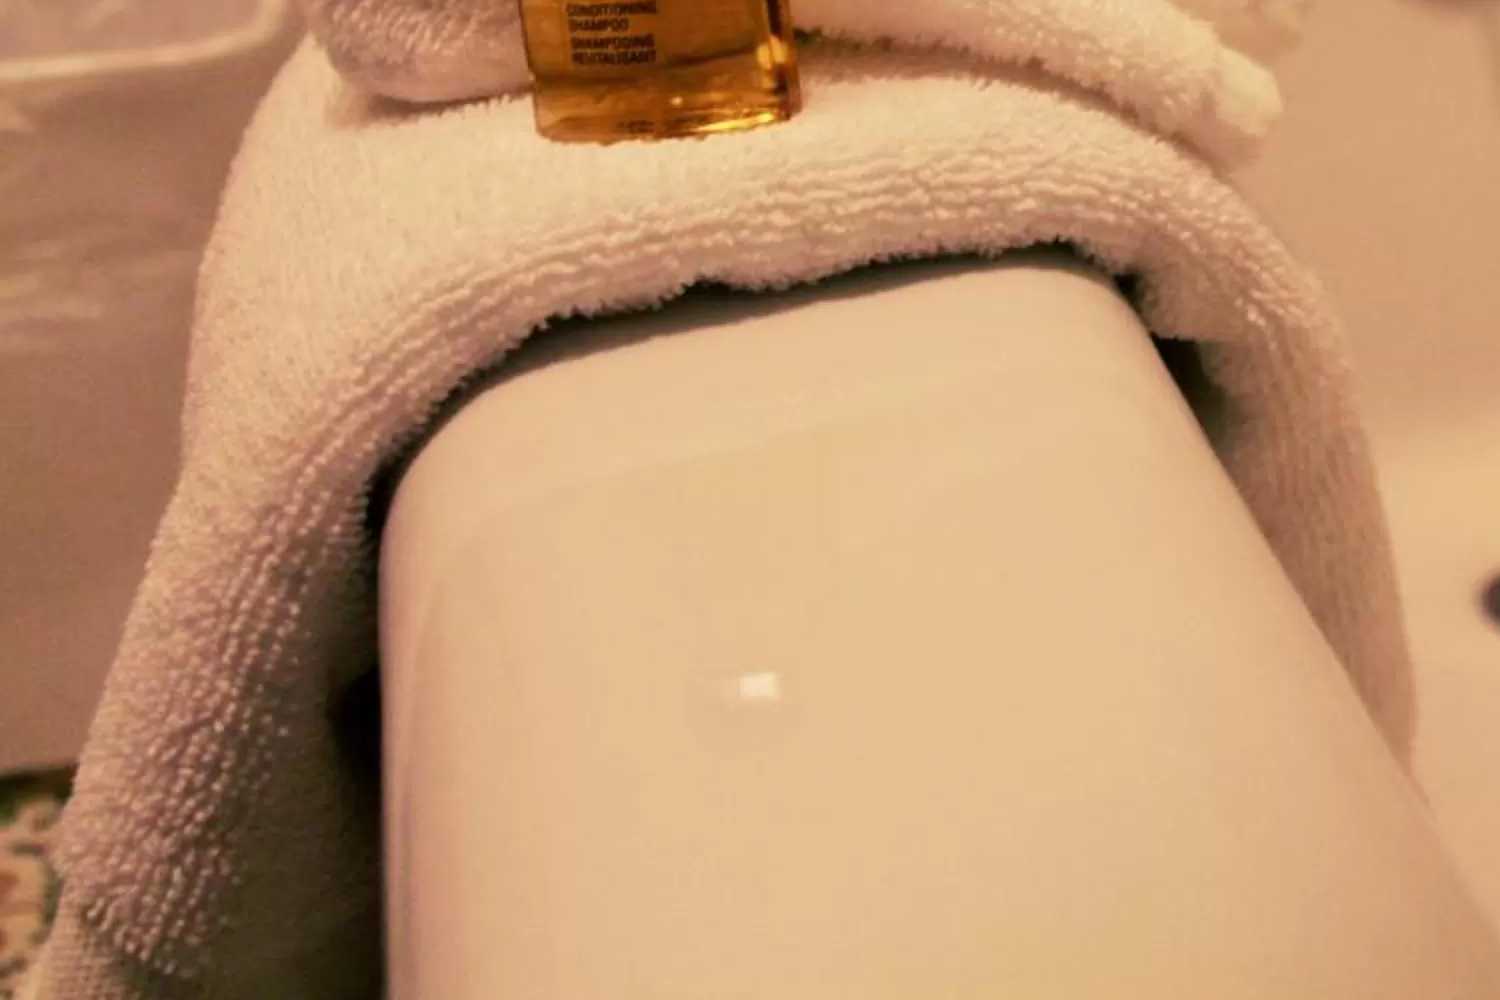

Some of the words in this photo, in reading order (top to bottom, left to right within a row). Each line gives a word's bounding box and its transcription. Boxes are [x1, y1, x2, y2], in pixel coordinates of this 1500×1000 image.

[566, 0, 657, 16] CONDITIONING
[568, 18, 629, 33] SHAMPOO
[571, 34, 655, 49] SHAMPOOING
[572, 50, 658, 66] REVITALISANT
